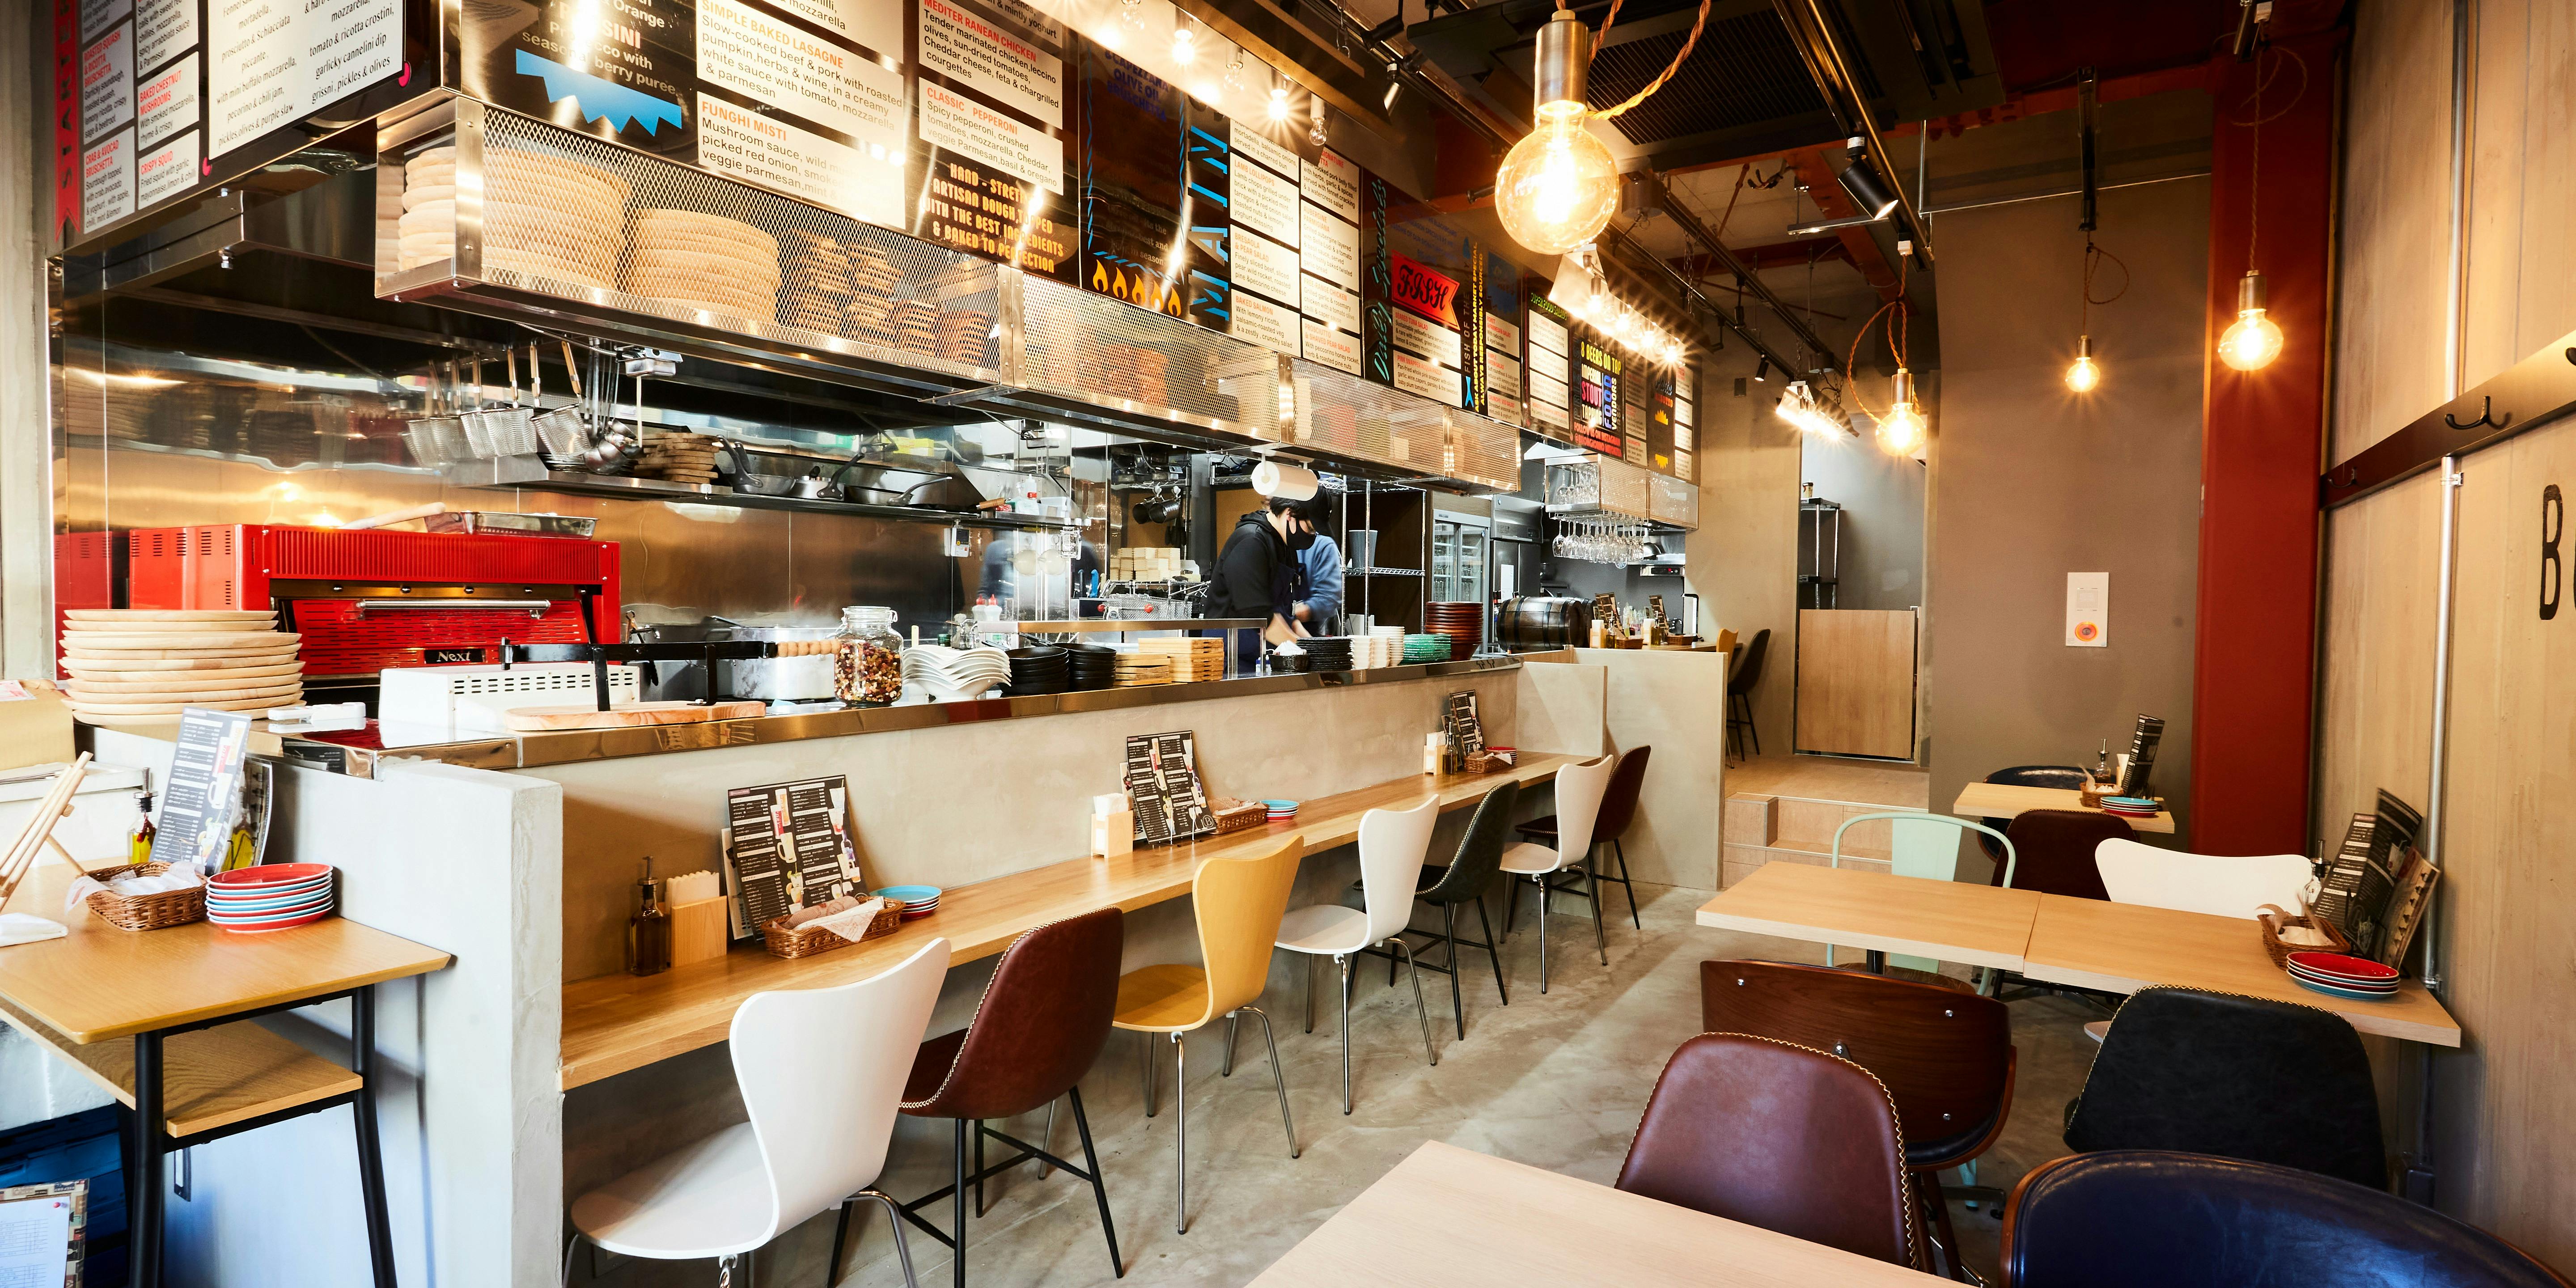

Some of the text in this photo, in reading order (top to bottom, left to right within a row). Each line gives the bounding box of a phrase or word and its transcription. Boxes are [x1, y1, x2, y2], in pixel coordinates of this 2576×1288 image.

[310, 3, 394, 57] tomato & ricotta crostini,
[614, 0, 665, 28] Orange
[924, 8, 954, 31] Tender
[957, 28, 996, 53] marinated
[703, 0, 843, 68] SIMPLE BAKED LASAGNE
[1001, 37, 1036, 62] CHICKEN
[316, 34, 386, 79] garlicky cannelini dip
[623, 51, 652, 70] with
[703, 15, 902, 107] Slow-cooked beef & pork with roasted
[924, 25, 1030, 84] olives, sun-dried tomatoes,
[927, 52, 971, 78] courgettes
[140, 70, 182, 102] BAKED CHESTNUT
[338, 71, 360, 92] pickles
[363, 66, 367, 77] &
[370, 56, 390, 73] olives
[595, 56, 633, 82] berry
[636, 73, 676, 95] puree
[703, 33, 888, 116] pumpkin,herbs & wine, in a creamy
[703, 48, 894, 129] white sauce with tomato, mozzarella
[924, 36, 1058, 108] Cheddar cheese, feta & chargrilled
[140, 91, 171, 116] MUSHROOMS
[928, 88, 1017, 134] CLASSIC PEPPERONI
[703, 101, 786, 140] FUNGHI MISTI
[928, 101, 1028, 151] Spicy pepperoni, crushed
[703, 118, 763, 147] Mushroom
[767, 143, 802, 162] sauce,
[141, 151, 173, 175] CRISPY SQUID
[703, 151, 741, 169] veggie
[950, 163, 979, 186] HAND
[1235, 160, 1274, 186] LAMB LOLLIPOPS
[933, 178, 979, 208] ARTISAN
[952, 206, 972, 226] THE
[976, 215, 1000, 235] BEST
[1187, 107, 1229, 321] MAIN
[933, 221, 941, 237] &
[945, 225, 979, 249] BAKED
[982, 237, 995, 254] TO
[1397, 264, 1449, 311] FISH
[1236, 296, 1273, 315] BAKED SALMON
[1236, 305, 1280, 327] With lemony ricotta,
[1464, 321, 1470, 338] OF
[1581, 341, 1585, 357] 8
[1586, 344, 1602, 367] BEERS
[1603, 353, 1611, 371] ON
[1612, 357, 1621, 375] TAP
[1581, 363, 1602, 386] IMPERIAL
[1581, 381, 1602, 407] STOUT
[2539, 484, 2576, 620] B
[436, 651, 471, 662] Next
